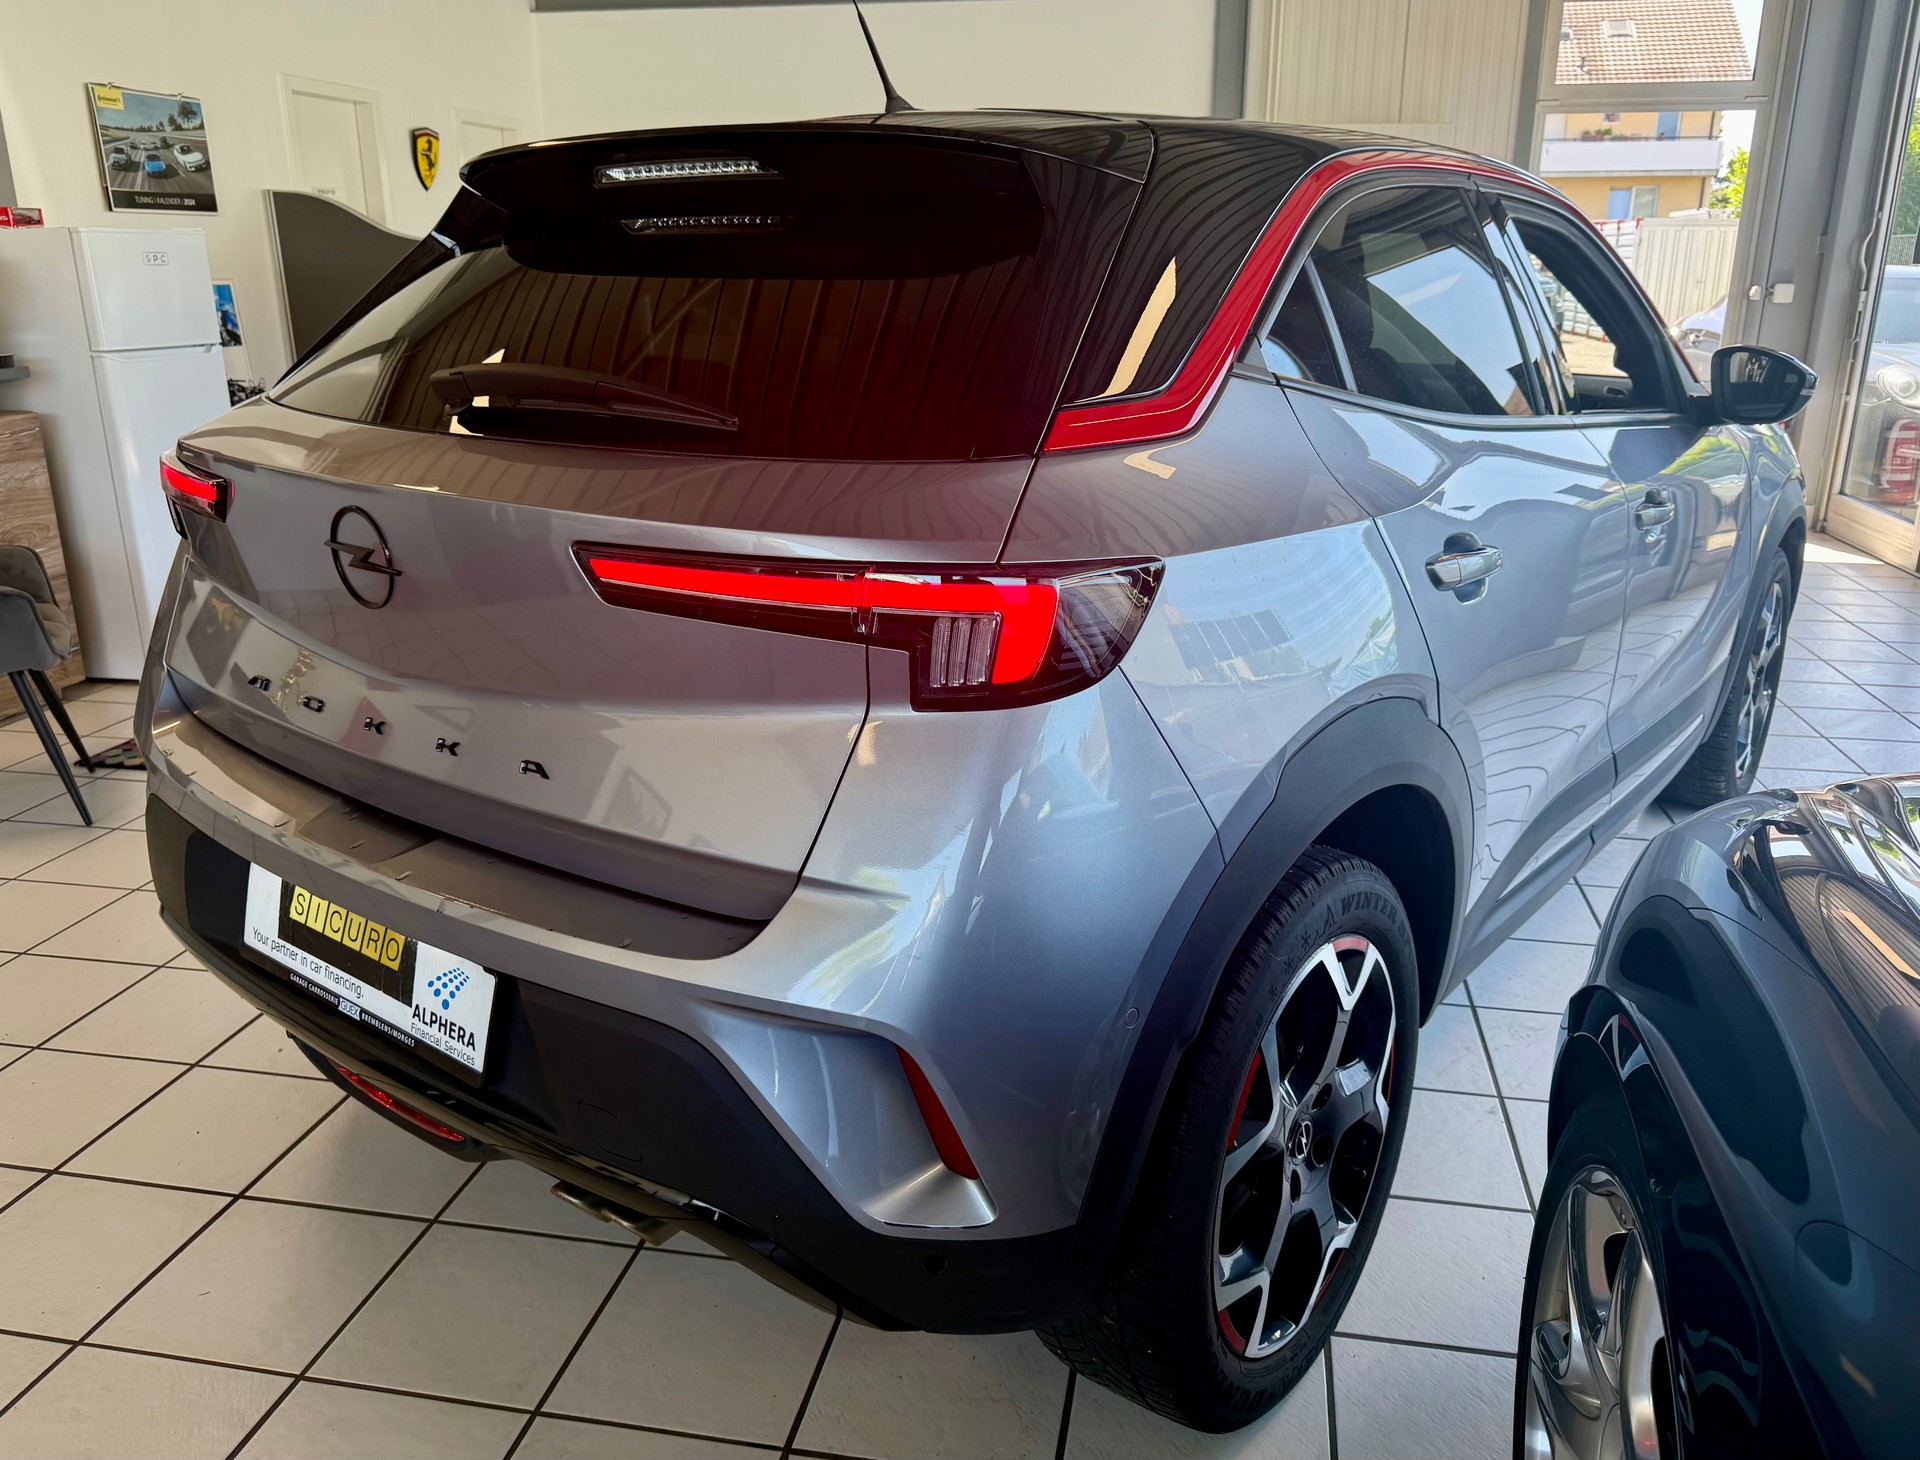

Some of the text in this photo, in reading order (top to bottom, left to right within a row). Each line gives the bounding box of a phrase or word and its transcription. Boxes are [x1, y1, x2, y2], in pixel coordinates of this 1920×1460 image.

[183, 198, 196, 206] 2024
[247, 674, 549, 780] MOKKA
[294, 892, 401, 962] SICURO
[1340, 891, 1398, 925] WINTER
[252, 926, 365, 1000] Your partner in car financing.
[290, 973, 415, 1047] GARAGE CARROSSERIE GUEX BREMBLENS/MORGES
[412, 1003, 476, 1052] ALPHERA
[411, 1022, 475, 1066] Financial Services
